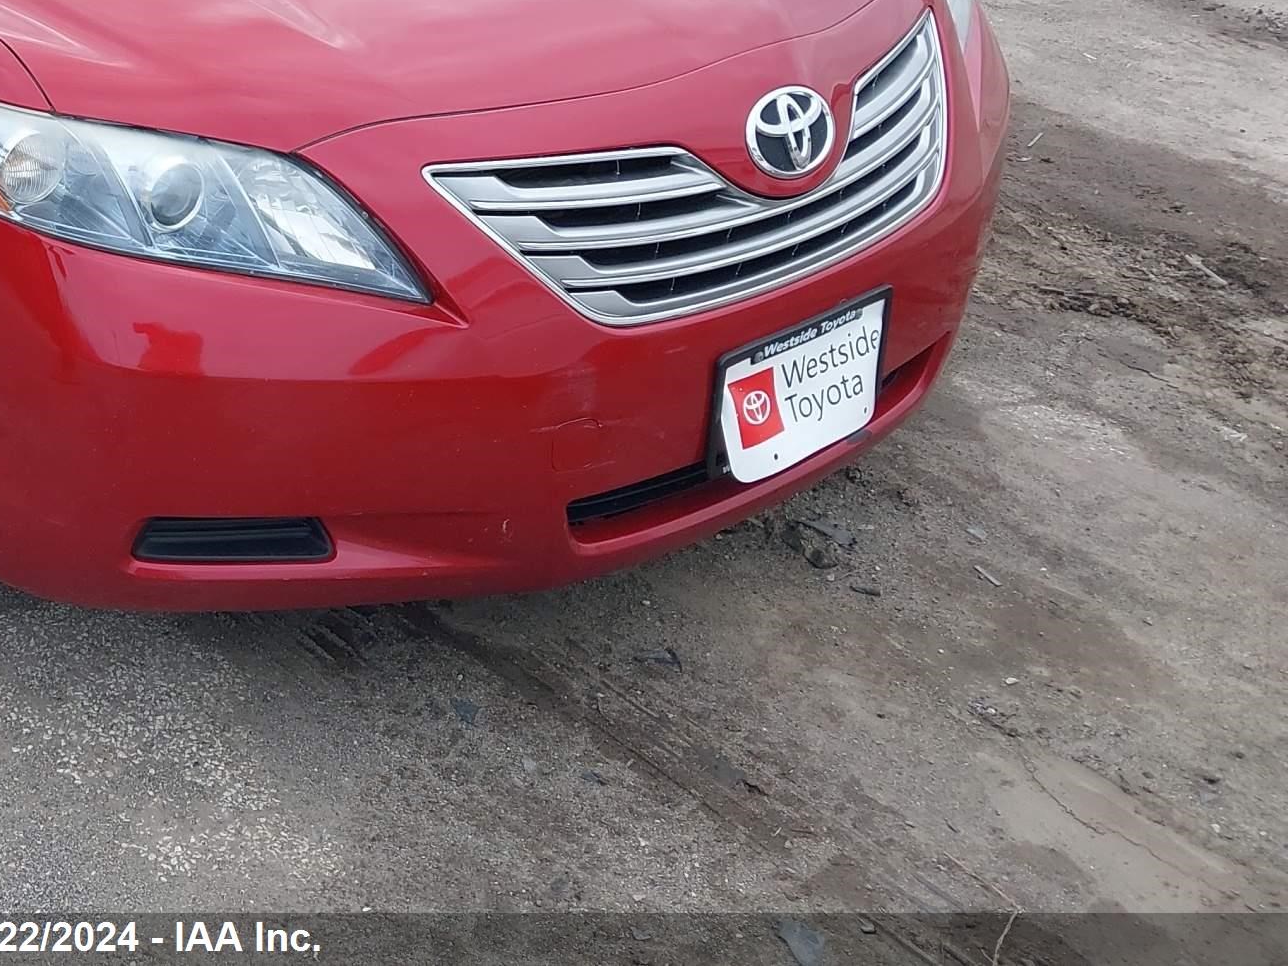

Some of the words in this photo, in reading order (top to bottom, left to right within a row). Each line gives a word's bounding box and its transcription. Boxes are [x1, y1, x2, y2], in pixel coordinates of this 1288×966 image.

[764, 328, 817, 357] Westside
[820, 310, 856, 333] Toyota
[781, 325, 880, 389] Westside
[785, 374, 864, 422] Toyota
